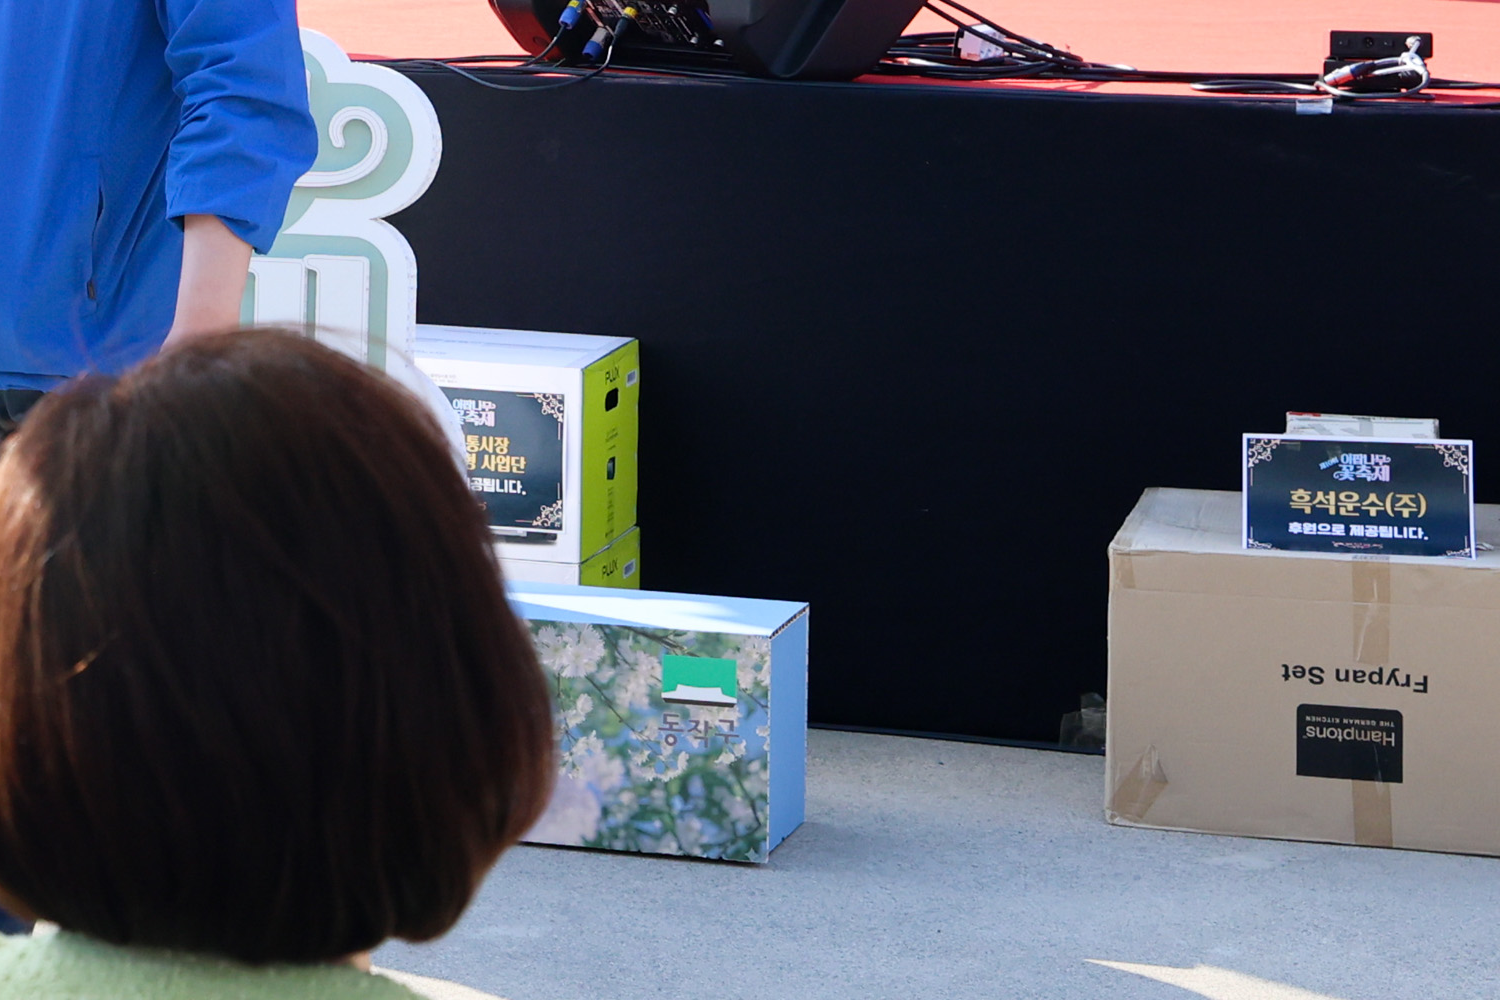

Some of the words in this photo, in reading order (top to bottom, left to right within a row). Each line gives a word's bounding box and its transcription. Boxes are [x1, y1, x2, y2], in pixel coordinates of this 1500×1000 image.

[465, 434, 510, 455] 통시장
[480, 454, 527, 474] 사업단
[1340, 452, 1392, 466] 이팝나무
[1332, 463, 1392, 483] 꽃축제
[467, 476, 527, 496] 공됩니다.
[1289, 488, 1428, 519] 흑석운수(주)
[1288, 521, 1346, 537] 후원으로
[1349, 523, 1430, 541] 제공됩니다.
[1280, 663, 1326, 686] Set
[1334, 665, 1429, 694] Frypan
[1305, 714, 1341, 724] KITCHEN
[1342, 718, 1377, 727] GERMAN
[1379, 720, 1396, 728] THE
[657, 712, 740, 749] 동작구
[1305, 725, 1396, 748] Hamptons
